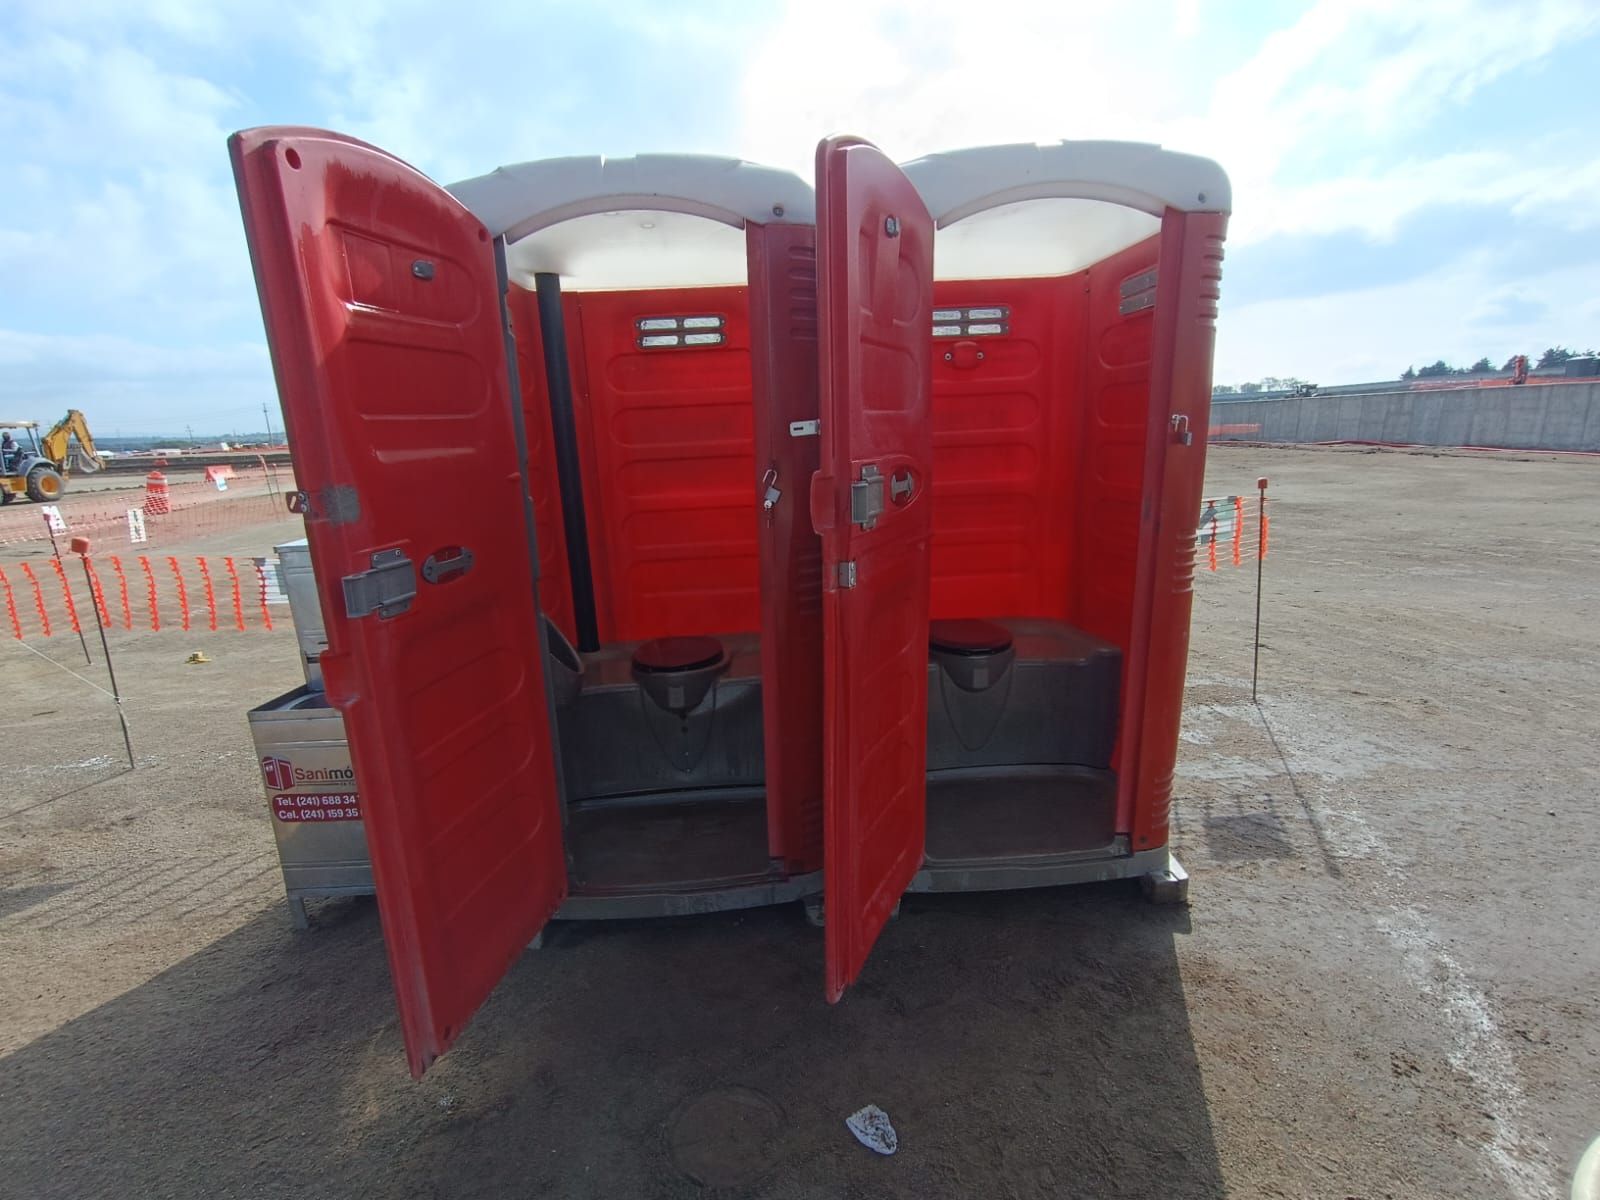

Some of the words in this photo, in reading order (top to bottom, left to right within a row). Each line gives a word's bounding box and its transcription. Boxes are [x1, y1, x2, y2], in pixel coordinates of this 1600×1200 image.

[275, 797, 294, 806] Tel.
[297, 797, 320, 807] (241)
[322, 796, 341, 805] 688
[342, 795, 356, 804] 34
[278, 810, 299, 819] Cel.
[301, 809, 325, 820] (241)
[327, 809, 344, 818] 159
[345, 808, 359, 817] 35
